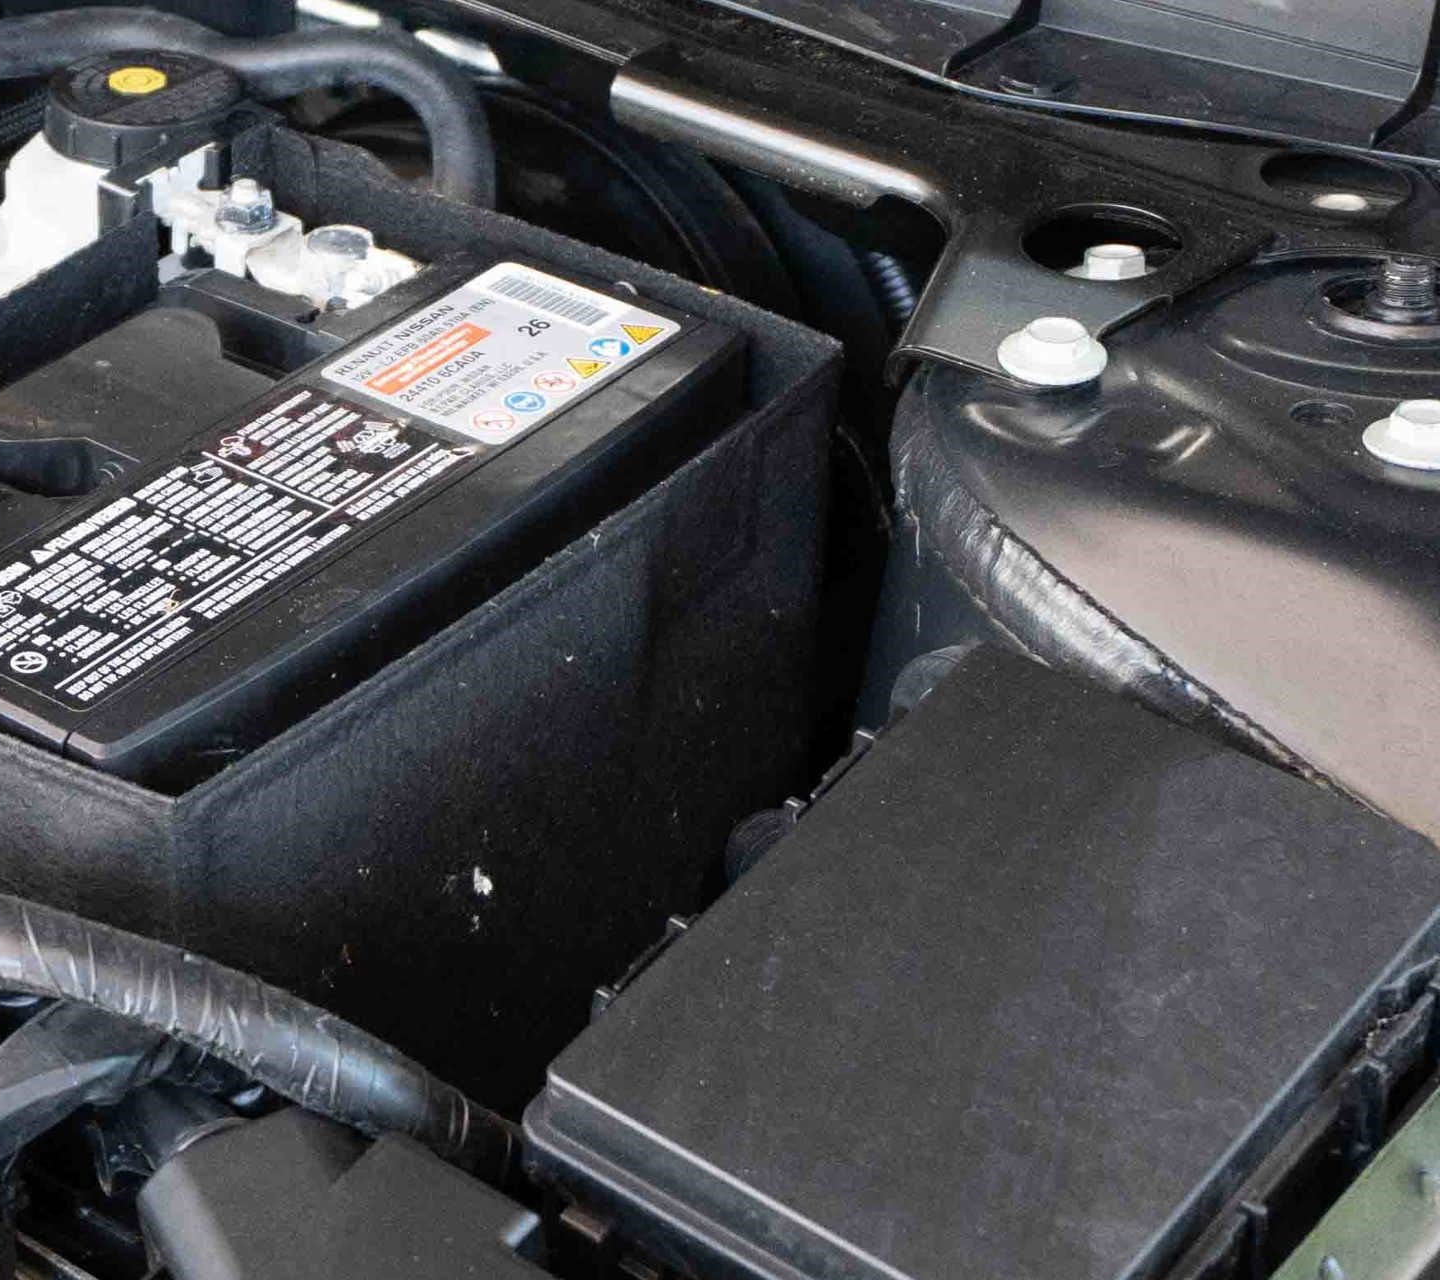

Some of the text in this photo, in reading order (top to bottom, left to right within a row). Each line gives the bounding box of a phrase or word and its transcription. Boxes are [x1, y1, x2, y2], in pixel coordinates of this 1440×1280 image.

[397, 305, 453, 340] NISSAN
[517, 319, 550, 337] 26
[400, 377, 441, 402] 24410
